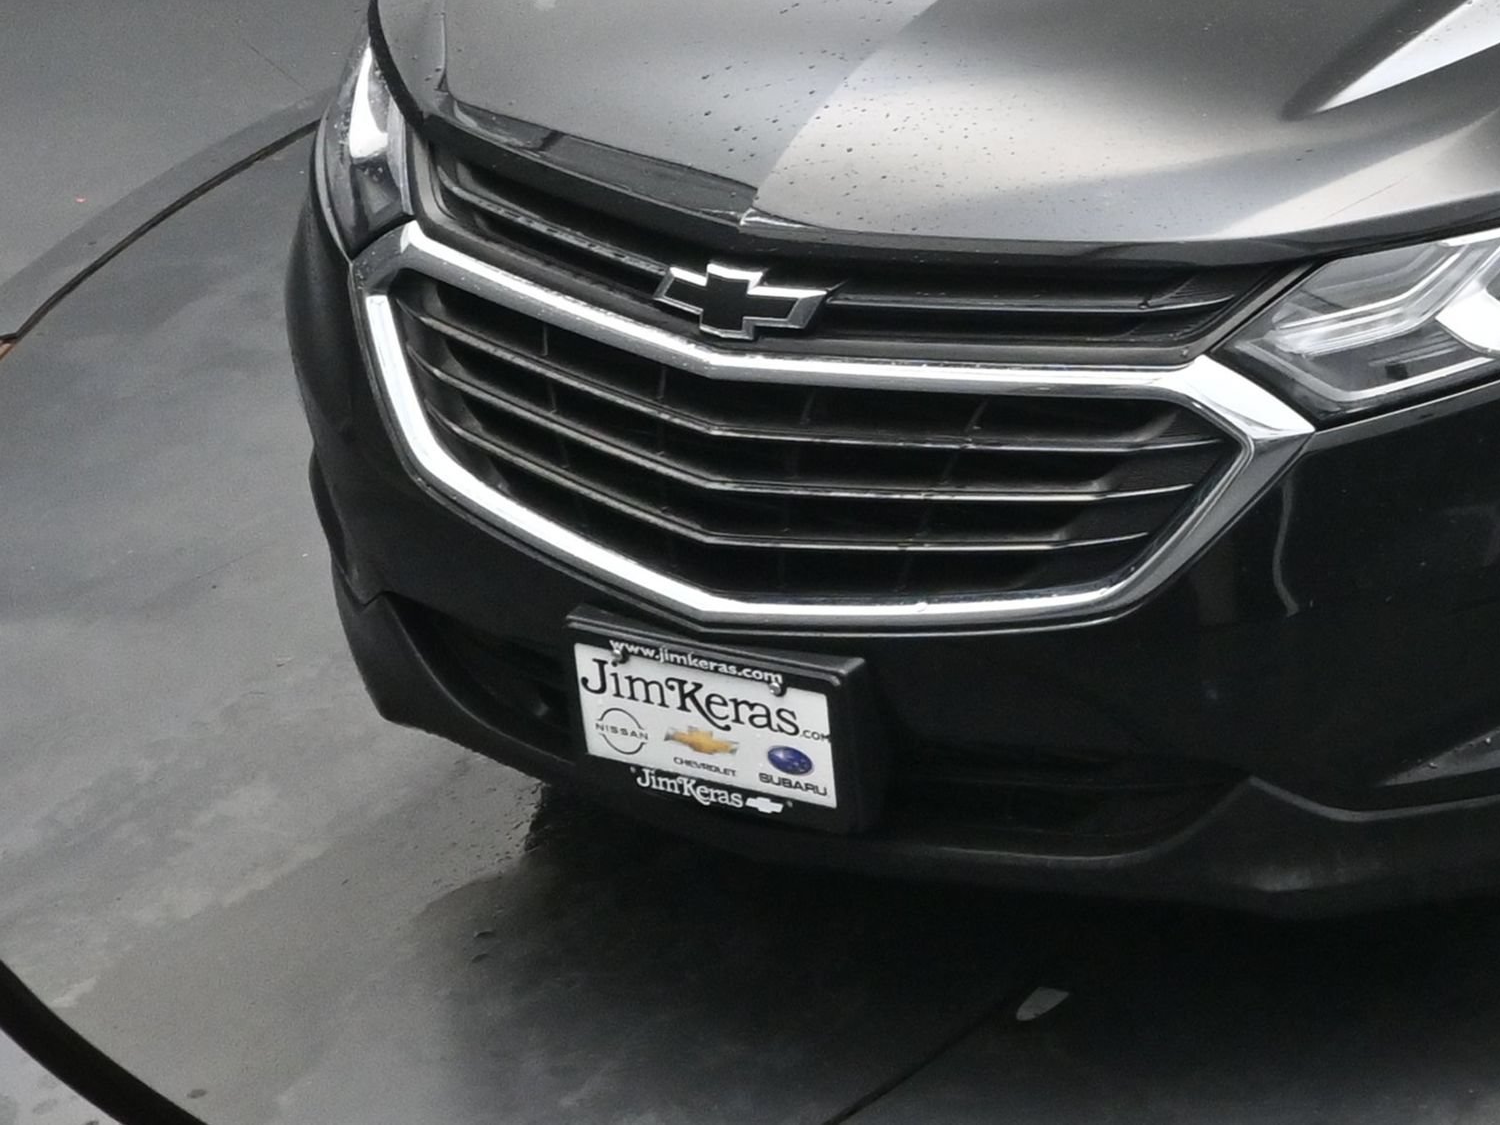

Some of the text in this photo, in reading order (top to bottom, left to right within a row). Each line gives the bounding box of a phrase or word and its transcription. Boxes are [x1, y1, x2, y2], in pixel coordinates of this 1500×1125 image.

[609, 639, 783, 685] www.jimkeras.com
[595, 721, 649, 741] NISSAN
[673, 756, 736, 777] CHEVROLET
[758, 772, 828, 797] SUBARU
